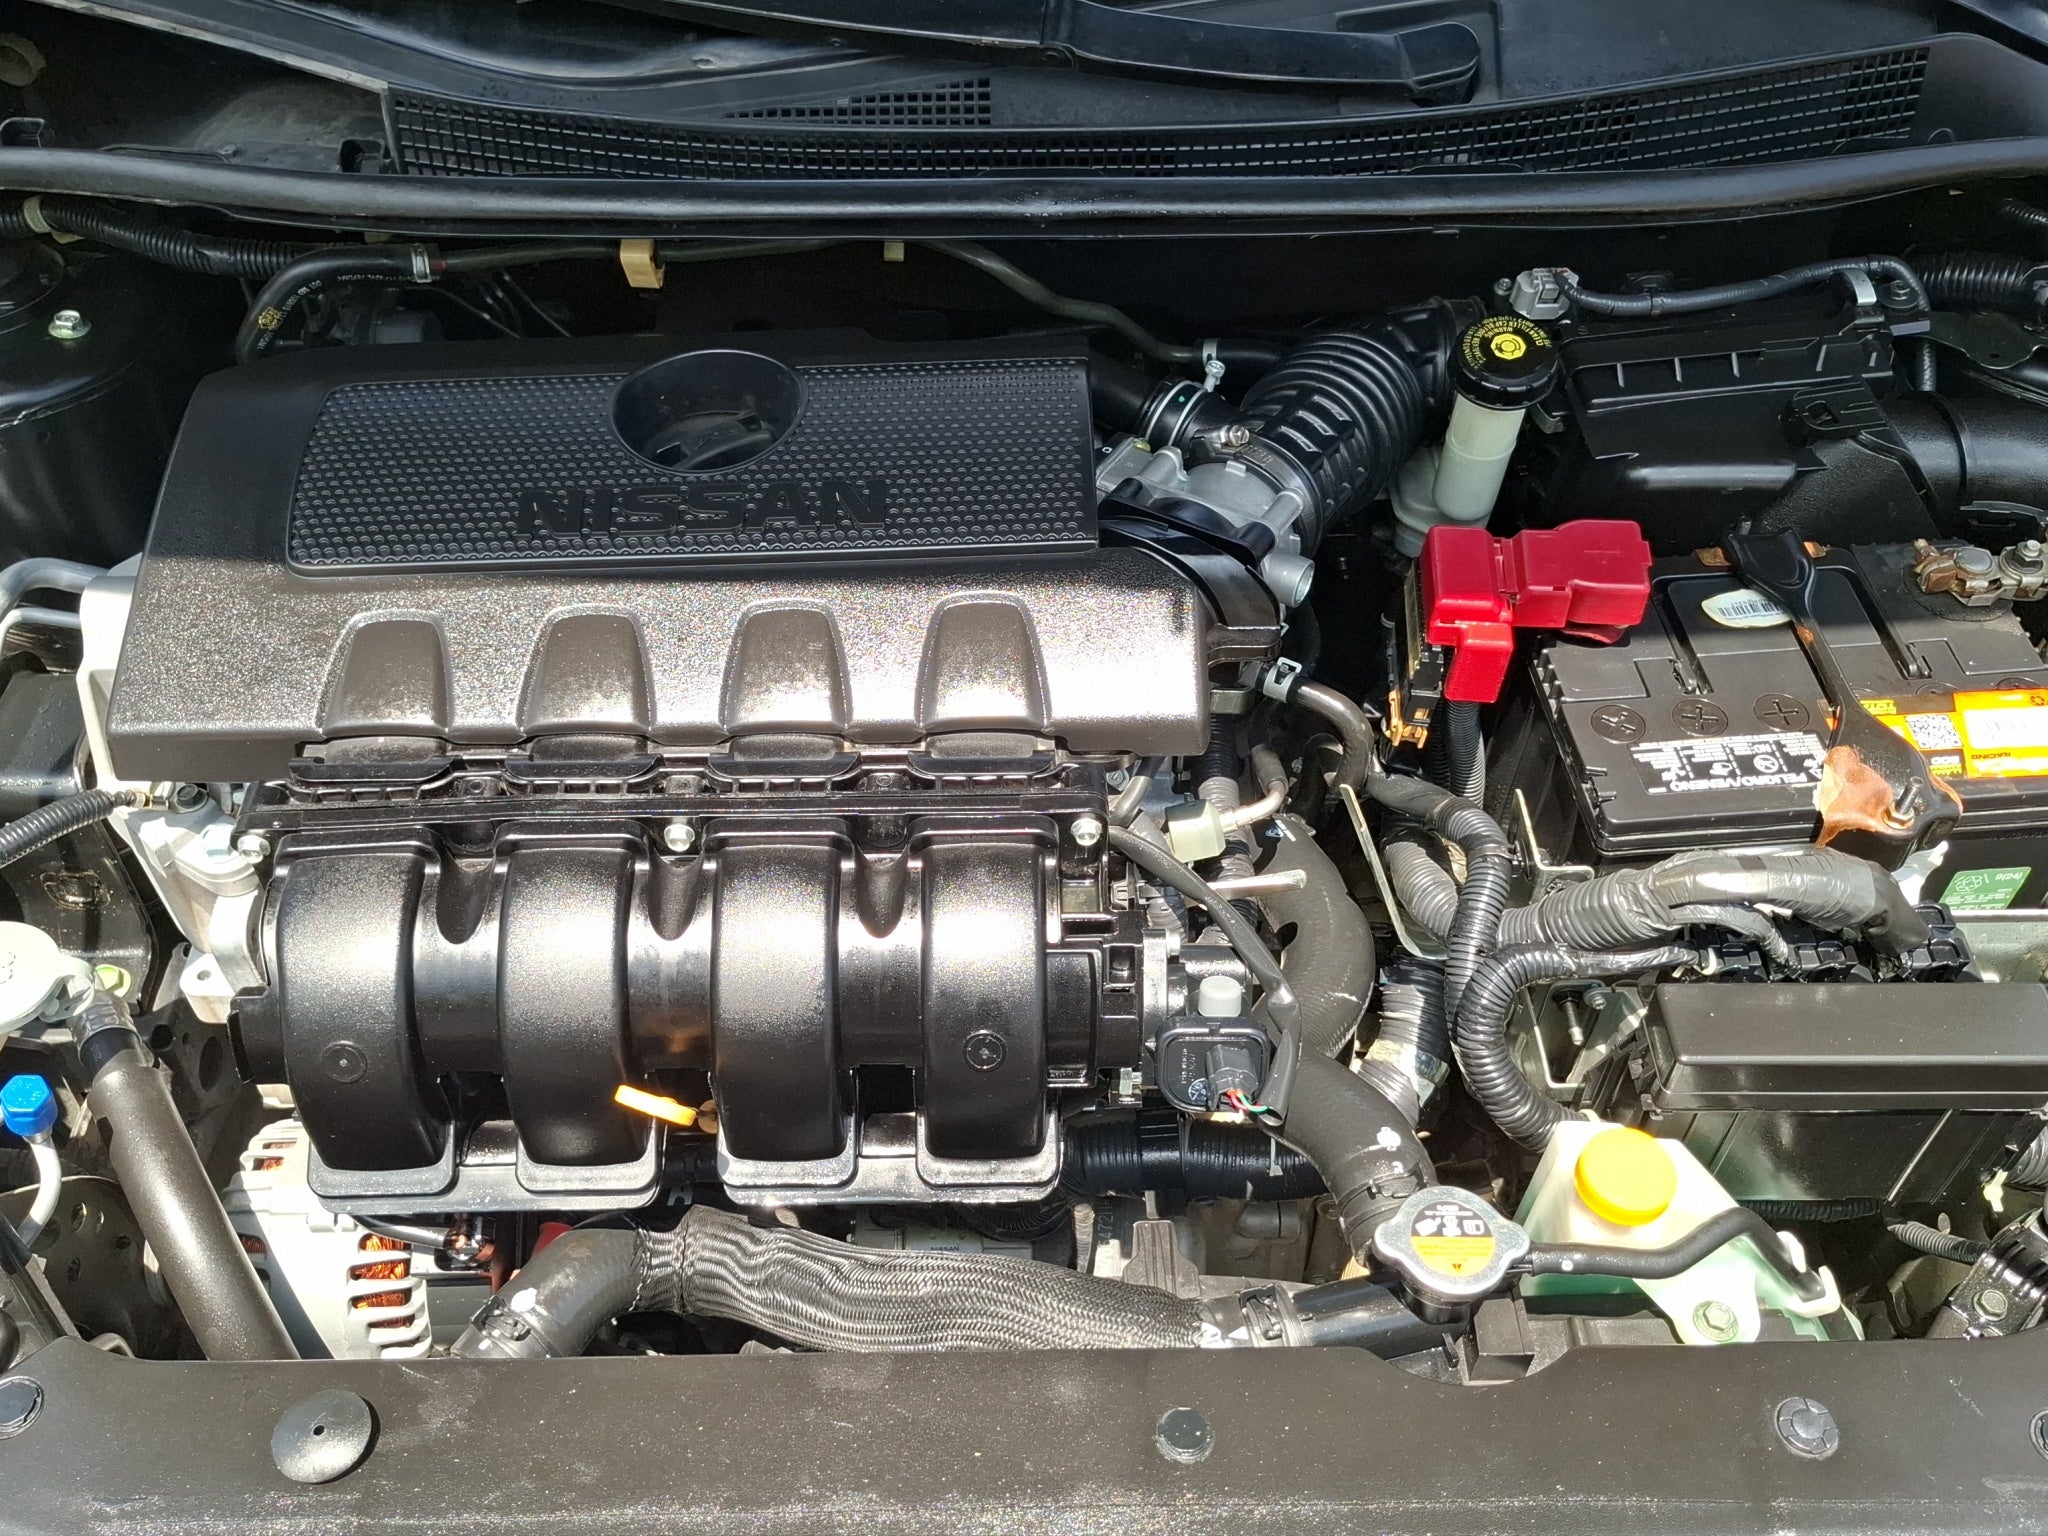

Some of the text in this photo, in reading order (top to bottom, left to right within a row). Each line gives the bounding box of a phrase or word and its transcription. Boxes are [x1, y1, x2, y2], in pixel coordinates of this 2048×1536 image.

[1484, 327, 1513, 338] WARNING
[1508, 321, 1531, 332] FILLER
[1529, 330, 1544, 346] CLEAN
[514, 480, 887, 540] NISSAN
[1970, 751, 2012, 760] RACING
[1669, 772, 1808, 792] PELIGRO/VENENO
